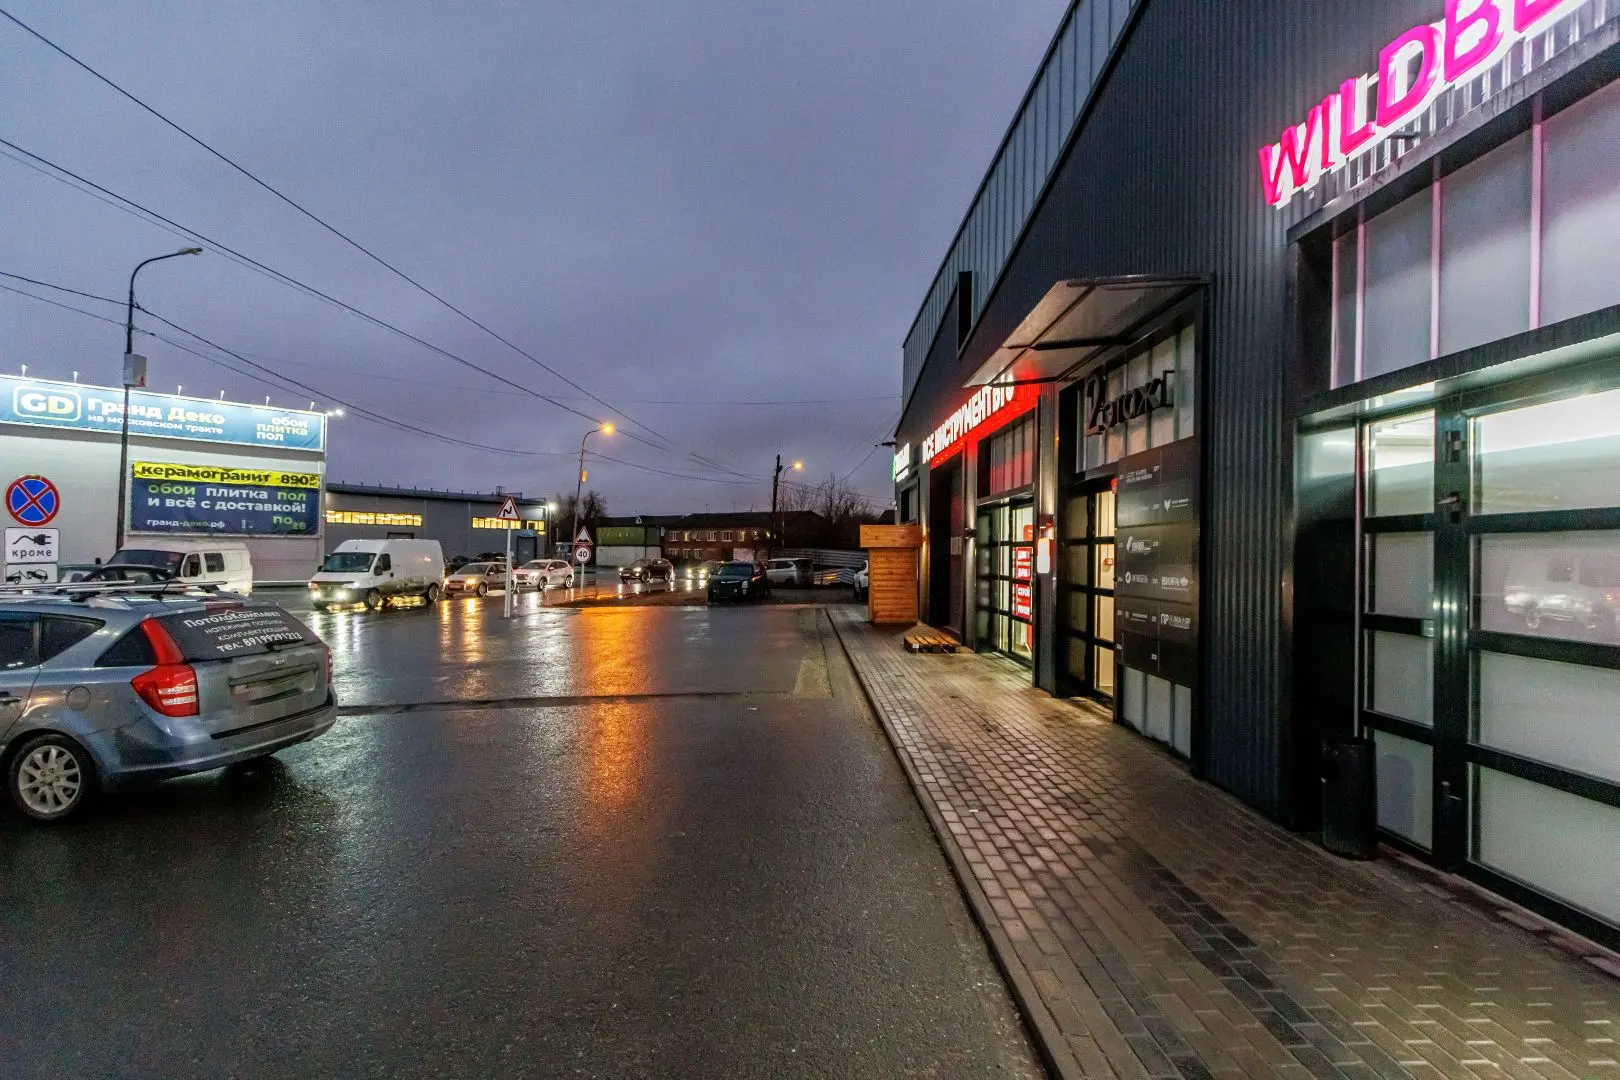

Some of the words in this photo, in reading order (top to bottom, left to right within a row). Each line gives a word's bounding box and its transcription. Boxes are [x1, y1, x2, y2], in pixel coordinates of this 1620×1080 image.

[20, 393, 75, 415] GD
[87, 397, 163, 420] Гранд
[167, 406, 226, 425] Деко
[87, 414, 104, 423] на
[106, 417, 183, 430] московском
[184, 423, 224, 434] тракте
[256, 423, 308, 436] плитка
[271, 416, 308, 428] обои
[256, 432, 284, 441] пол
[141, 466, 271, 483] керамогранит
[148, 482, 197, 496] обои
[206, 487, 268, 499] плитка
[277, 490, 307, 501] пол
[147, 497, 160, 507] и
[165, 497, 197, 508] всё
[200, 500, 212, 509] с
[215, 501, 307, 513] доставкой!
[12, 549, 52, 559] кроме
[578, 550, 588, 558] 40
